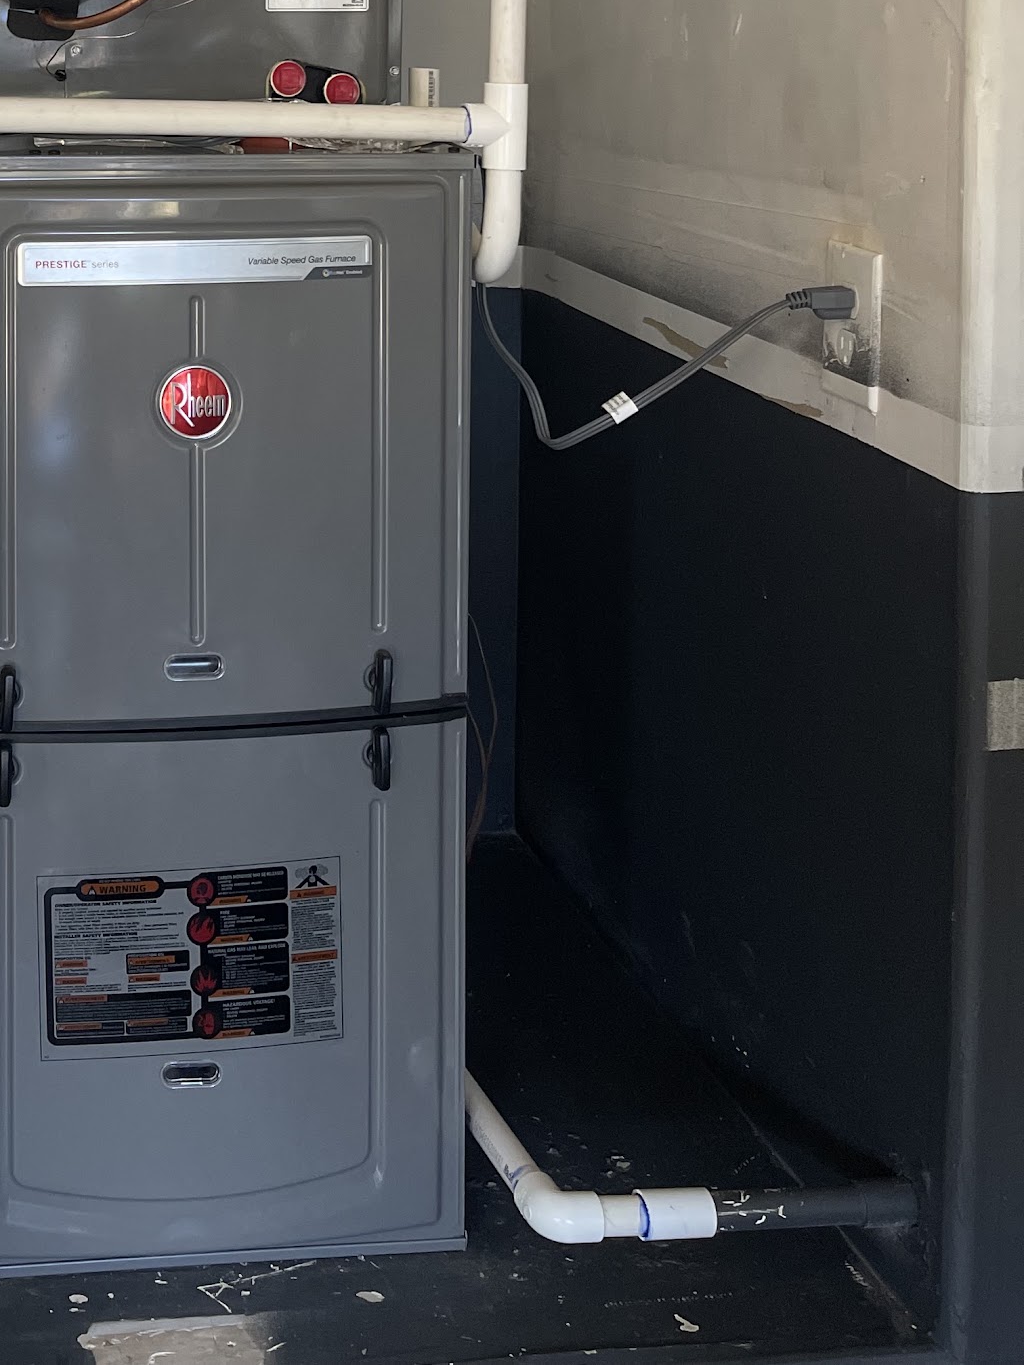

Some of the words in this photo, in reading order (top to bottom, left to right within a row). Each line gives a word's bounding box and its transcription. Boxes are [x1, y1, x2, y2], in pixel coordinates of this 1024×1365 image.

[35, 260, 87, 269] PRESTIGE
[91, 260, 119, 269] series
[248, 256, 279, 265] Variable
[280, 256, 306, 266] Speed
[308, 255, 323, 264] Gas
[325, 254, 356, 263] Furnace
[170, 372, 226, 427] Rheem
[99, 884, 147, 894] WARNING
